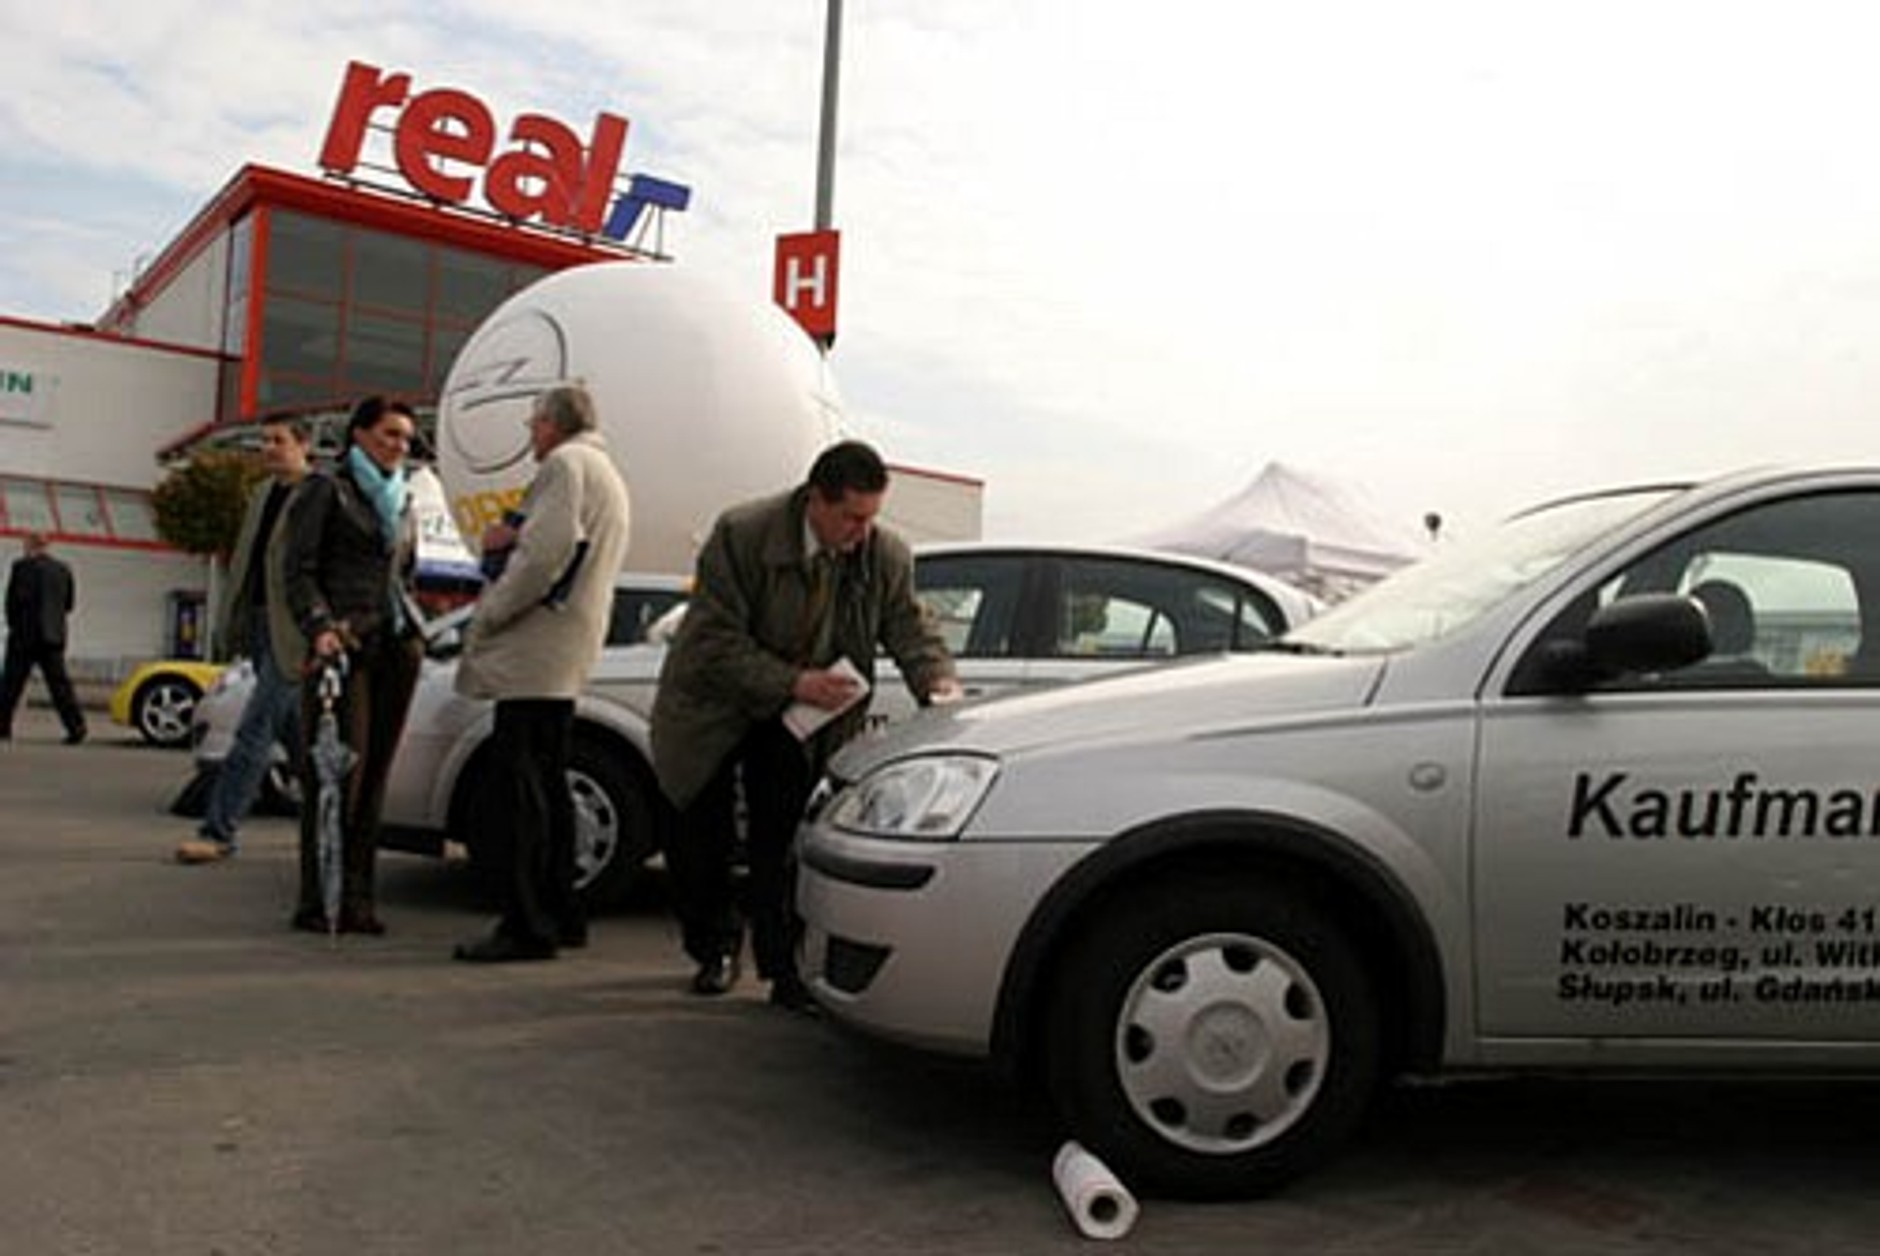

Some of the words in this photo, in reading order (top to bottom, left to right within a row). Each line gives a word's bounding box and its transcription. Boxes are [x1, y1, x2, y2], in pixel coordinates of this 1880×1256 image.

[786, 255, 825, 309] H
[1567, 772, 1880, 838] Kaufma
[1563, 903, 1717, 931] Koszalin
[1837, 908, 1875, 932] 41
[1761, 941, 1802, 968] ul.
[1698, 976, 1740, 1002] ul.
